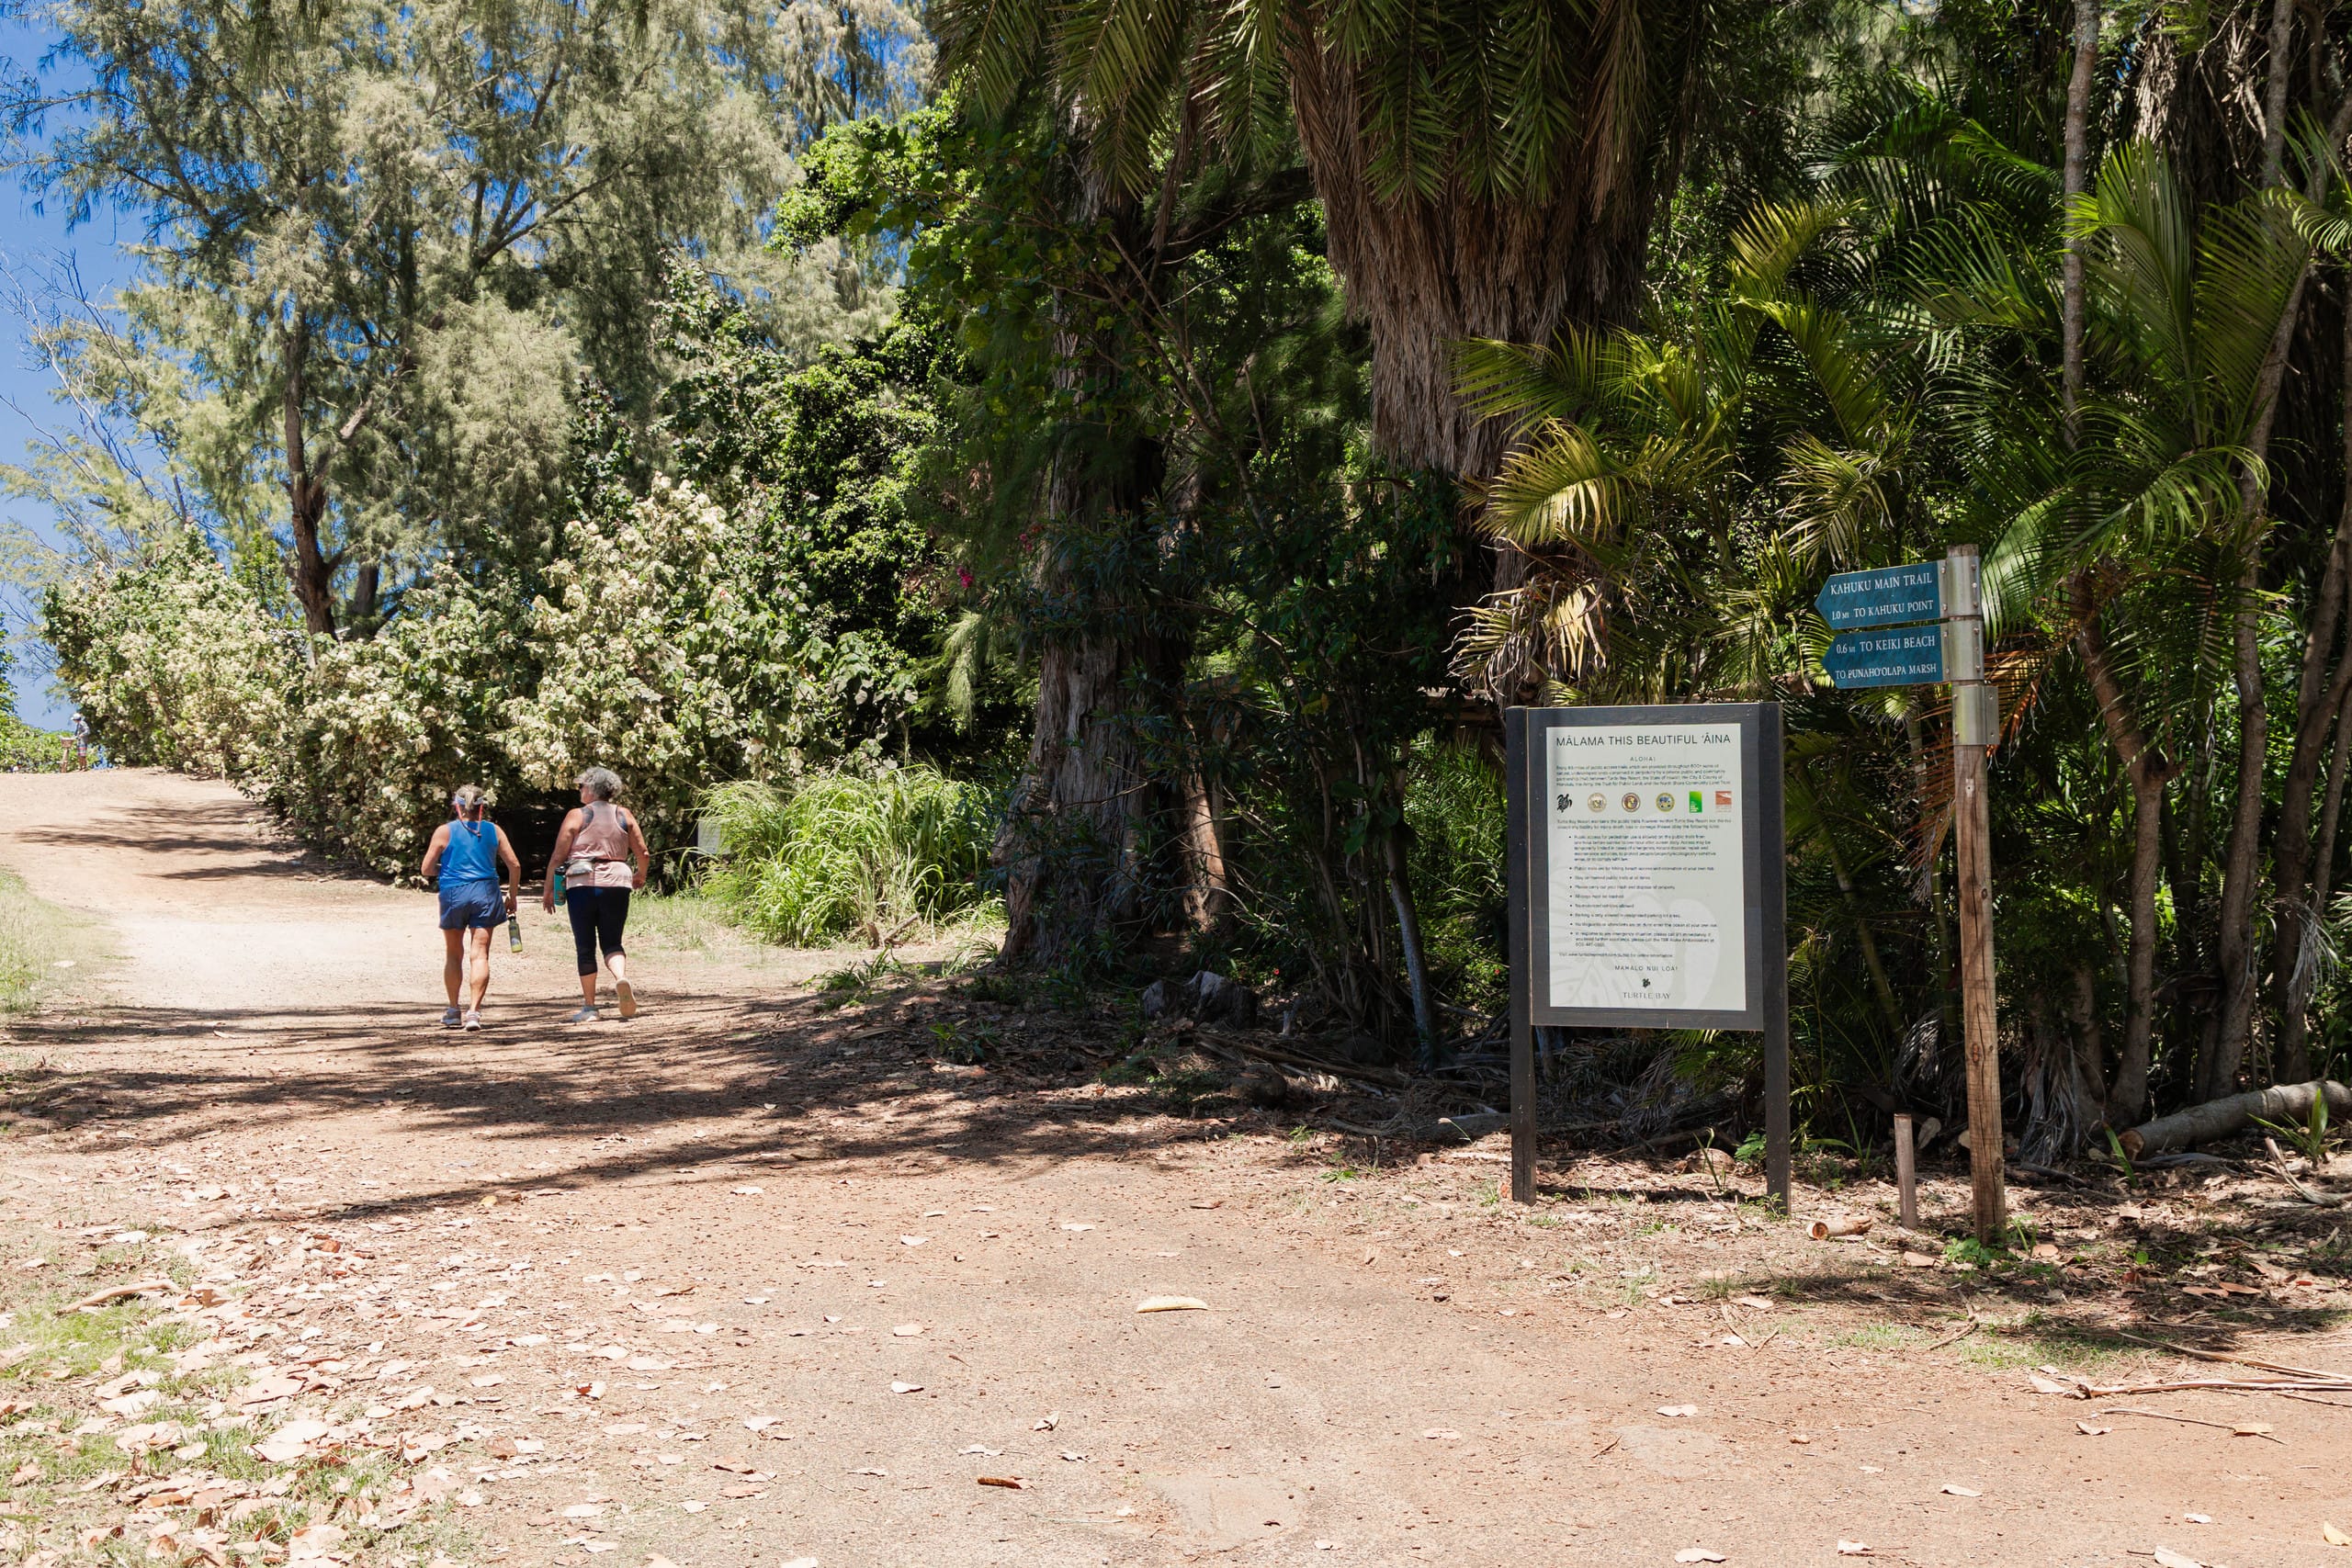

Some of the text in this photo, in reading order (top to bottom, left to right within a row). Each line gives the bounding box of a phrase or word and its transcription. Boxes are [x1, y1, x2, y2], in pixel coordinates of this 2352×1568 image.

[1830, 572, 1933, 595] KAHUKU MAIN TRAIL
[1853, 607, 1866, 618] TO
[1868, 604, 1905, 616] KAHUKU
[1907, 600, 1934, 613] POINT
[1836, 644, 1849, 654] 0.6
[1859, 641, 1873, 652] TO
[1875, 638, 1901, 651] KEIKI
[1904, 635, 1936, 649] BEACH
[1835, 670, 1846, 680] TO
[1908, 663, 1937, 675] MARSH
[1608, 736, 1634, 746] THIS
[1636, 735, 1698, 745] BEAUTIFUL
